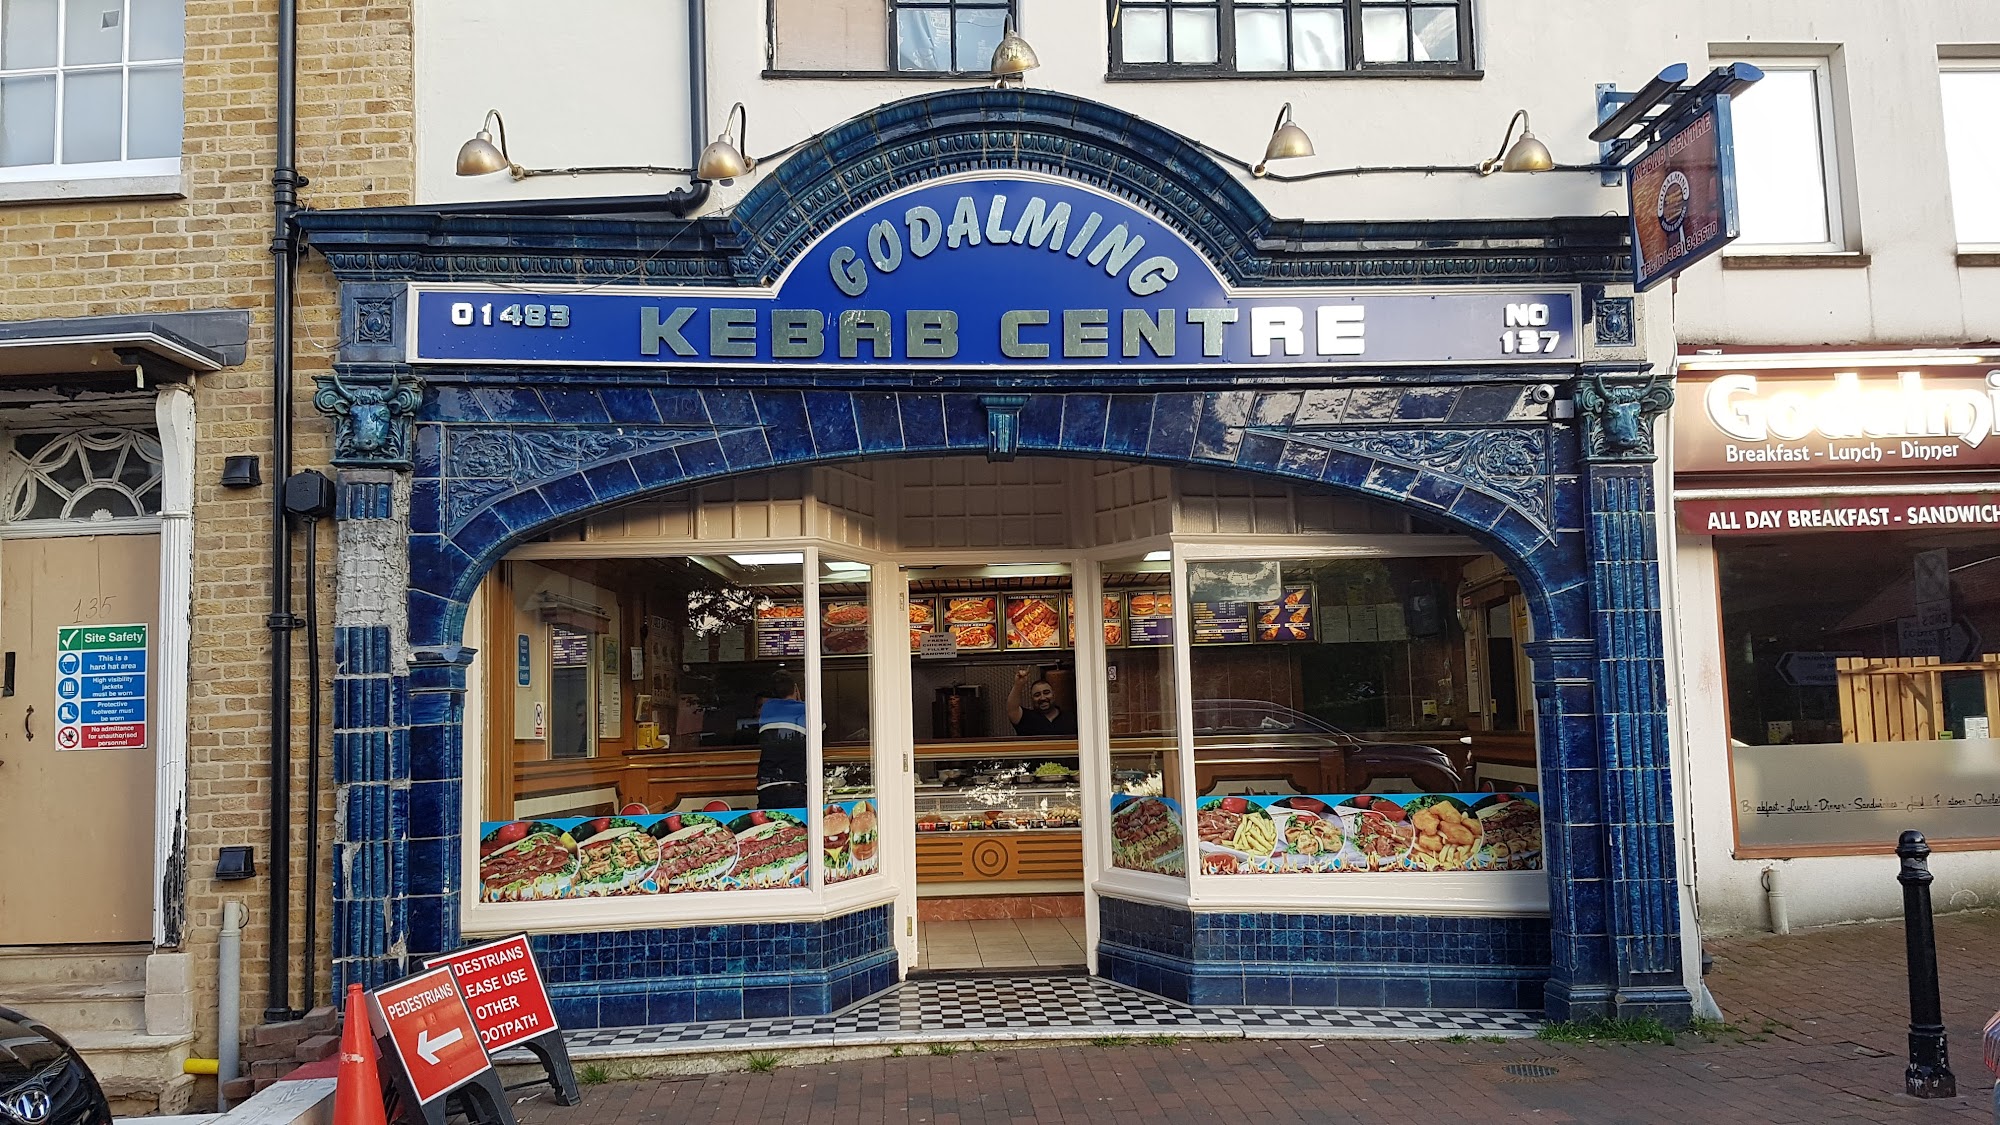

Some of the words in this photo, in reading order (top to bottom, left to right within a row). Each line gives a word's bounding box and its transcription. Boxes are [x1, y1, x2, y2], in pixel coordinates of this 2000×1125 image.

[1632, 145, 1666, 181] KEBAB
[1667, 111, 1712, 158] CENTRE
[829, 194, 1179, 296] GODALMING
[451, 302, 570, 328] 01483
[1504, 302, 1549, 327] NO
[640, 306, 960, 358] KEBAB
[1000, 305, 1366, 358] CENTRE
[1499, 329, 1560, 354] 137
[1725, 442, 1810, 462] Breakfast
[1828, 441, 1882, 462] Lunch
[1900, 440, 1959, 461] Dinner
[1707, 511, 1740, 530] ALL
[1744, 510, 1782, 529] DAY
[1787, 507, 1890, 528] BREAKFAST
[73, 595, 117, 624] 135
[84, 632, 106, 643] Site
[108, 631, 144, 645] Safety
[90, 663, 106, 671] hard
[92, 676, 107, 685] High
[108, 675, 133, 684] visibility
[92, 690, 108, 698] must
[97, 700, 128, 708] Protective
[91, 708, 118, 716] footwear
[97, 732, 138, 741] unauthorised
[101, 724, 135, 732] admittance
[97, 740, 128, 748] personnel
[1740, 799, 1780, 817] Brakfast
[464, 976, 502, 1000] EASE
[501, 968, 528, 987] USE
[387, 982, 454, 1021] PEDESTRIANS
[475, 995, 521, 1020] OTHER
